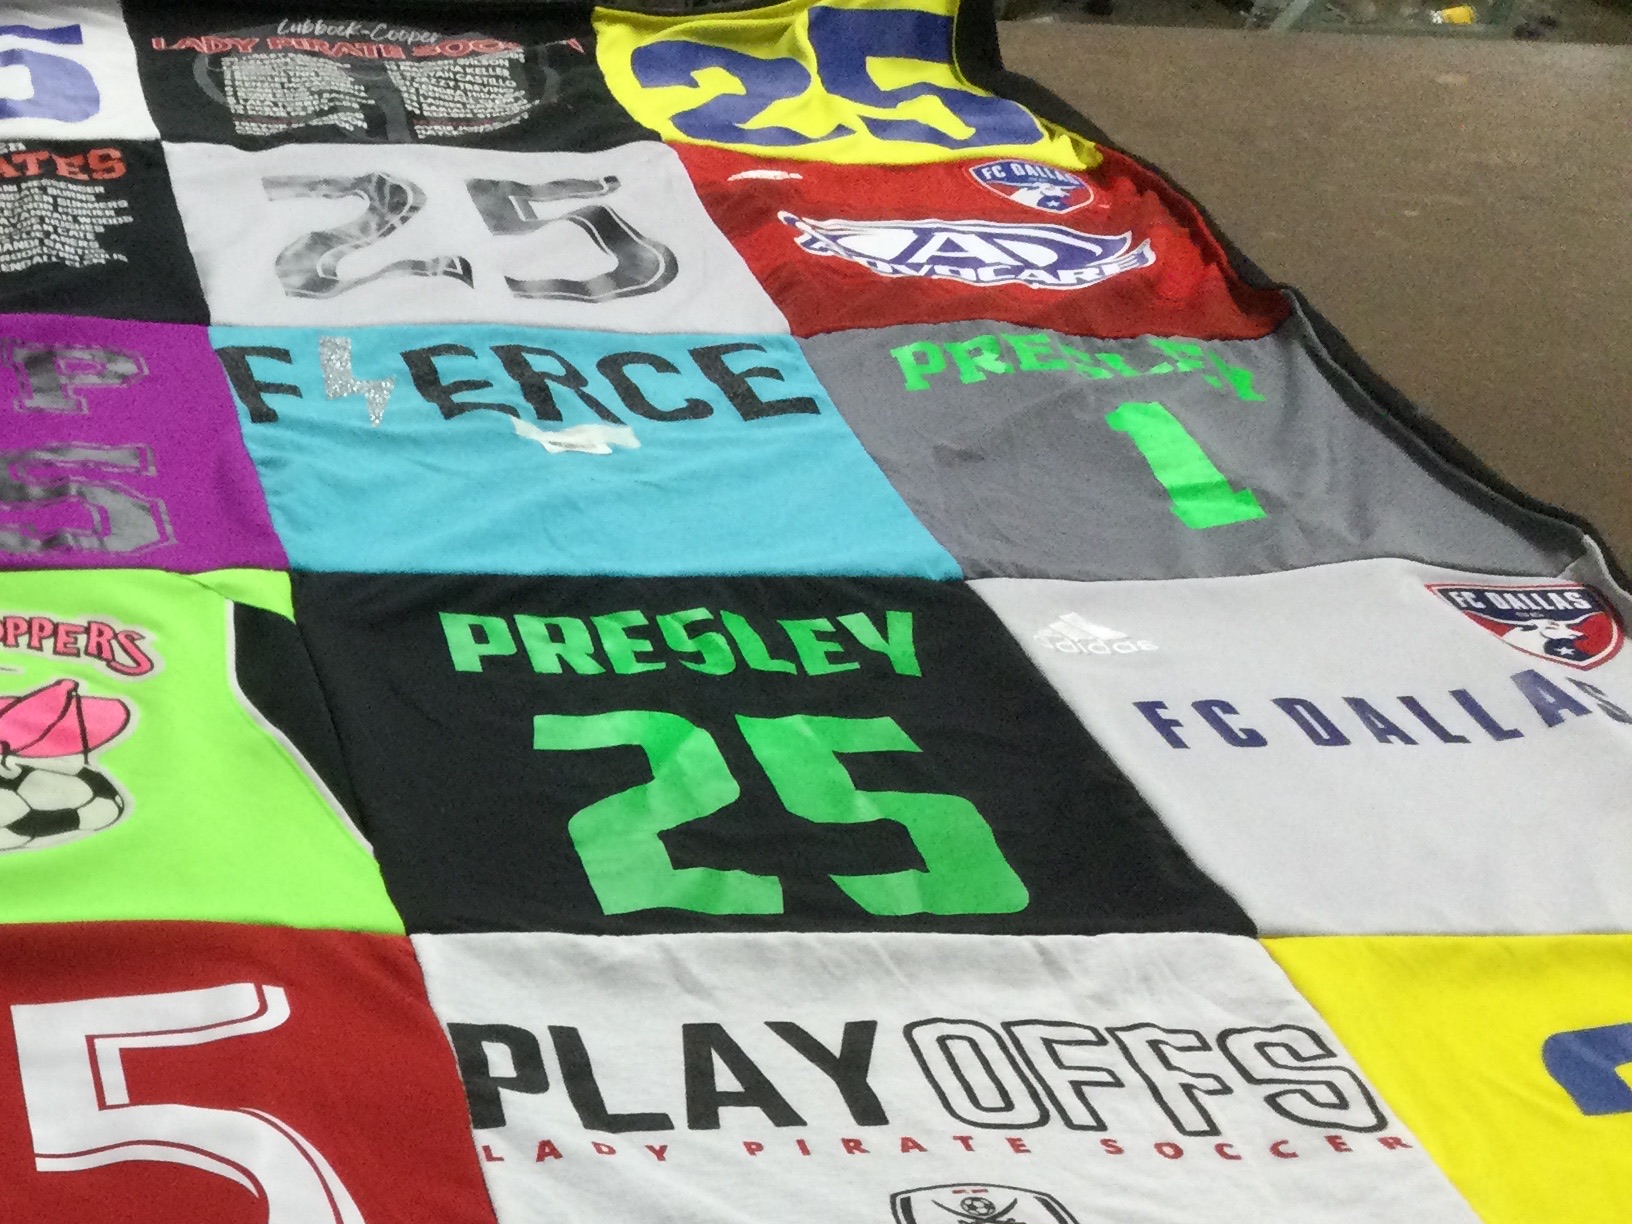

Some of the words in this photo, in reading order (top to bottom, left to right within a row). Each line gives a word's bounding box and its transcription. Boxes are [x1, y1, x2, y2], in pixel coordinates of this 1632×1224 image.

[630, 5, 1045, 149] 25
[981, 164, 1007, 180] FC
[262, 172, 679, 303] 25
[1104, 401, 1267, 530] 1
[1448, 590, 1487, 610] FC
[1483, 590, 1593, 611] DALLAS
[438, 607, 923, 678] PRESLEY
[1032, 631, 1160, 656] adidas
[1133, 697, 1269, 750] FC
[1270, 667, 1632, 749] DALLAS
[533, 709, 1030, 916] 25
[445, 1016, 1389, 1138] PLAYOFFS
[481, 1139, 674, 1163] LADY
[743, 1135, 1033, 1157] PIRATE
[1104, 1135, 1414, 1162] SOCCER
